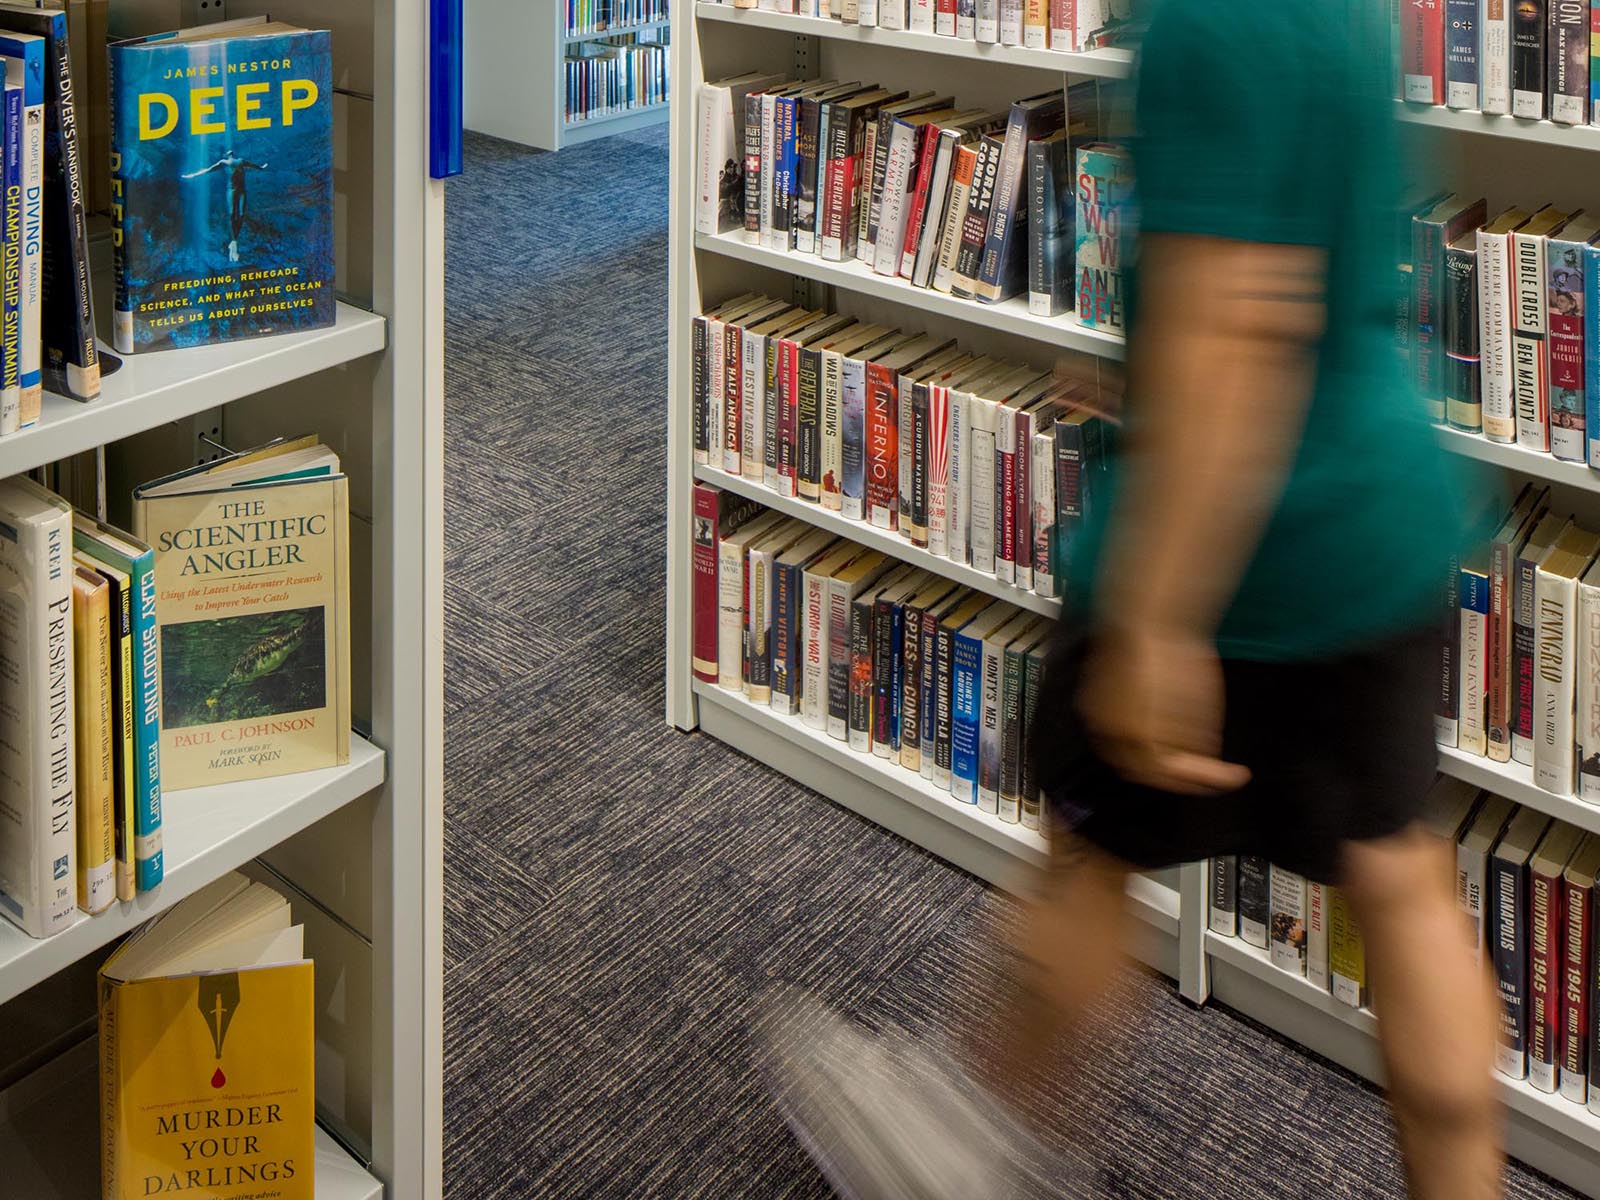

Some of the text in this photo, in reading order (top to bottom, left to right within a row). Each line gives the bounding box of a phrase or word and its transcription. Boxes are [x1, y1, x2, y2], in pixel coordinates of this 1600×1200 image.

[163, 59, 292, 80] JAMES NESTOR
[1558, 28, 1566, 92] MAX HASTINGS
[59, 54, 81, 207] THE DIVER'S HANDBOOK
[138, 78, 319, 142] DEEP
[112, 152, 123, 248] DEEP
[885, 147, 898, 204] ARMIES
[892, 137, 908, 222] EISENHOWER'S
[969, 142, 988, 207] COMBAT
[979, 145, 999, 210] MORAL
[1036, 154, 1044, 225] FLYBOYS
[5, 185, 20, 302] CHAMPIONSHIP
[25, 128, 42, 306] COMPLETE DIVING MANUAL
[80, 281, 90, 318] MOUNTAIN
[139, 280, 322, 312] SCIENCE, AND WHAT THE OCEAN
[163, 267, 299, 291] FREEDIVING, RENEGADE
[1519, 242, 1538, 326] DOUBLE CROSS
[149, 298, 314, 328] TELLS US ABOUT OURSELVES
[86, 337, 95, 366] FALCON
[727, 367, 736, 451] HALF AMERICA
[873, 390, 887, 480] INFERNO
[157, 514, 327, 553] SCIENTIFIC
[218, 499, 266, 519] THE
[48, 528, 61, 580] KREH
[179, 544, 305, 577] ANGLER
[160, 572, 323, 603] Using the Latest Underwater Research
[194, 592, 289, 613] to Improve Your Catch
[140, 569, 159, 726] CLAY SHOOTING
[1541, 598, 1563, 684] LENINGRAD
[937, 630, 948, 738] LOST IN SHANGRI-LA
[985, 654, 998, 730] MONTY'S MEN
[47, 595, 74, 838] PRESENTING THE FLY
[125, 700, 133, 741] ARCHERY
[173, 716, 316, 748] PAUL C. JOHNSON
[1545, 690, 1555, 746] ANNA REID
[147, 740, 161, 825] PETER CROFT
[208, 749, 282, 769] MARK SOSIN
[1500, 871, 1515, 952] INDIANAPOLIS
[1534, 878, 1548, 993] COUNTDOWN 1945
[1567, 888, 1583, 1074] COUNTDOWN 1945 CHRIS WALLACE
[155, 1103, 283, 1136] MURDER
[180, 1135, 261, 1161] YOUR
[144, 1158, 295, 1197] DARLINGS
